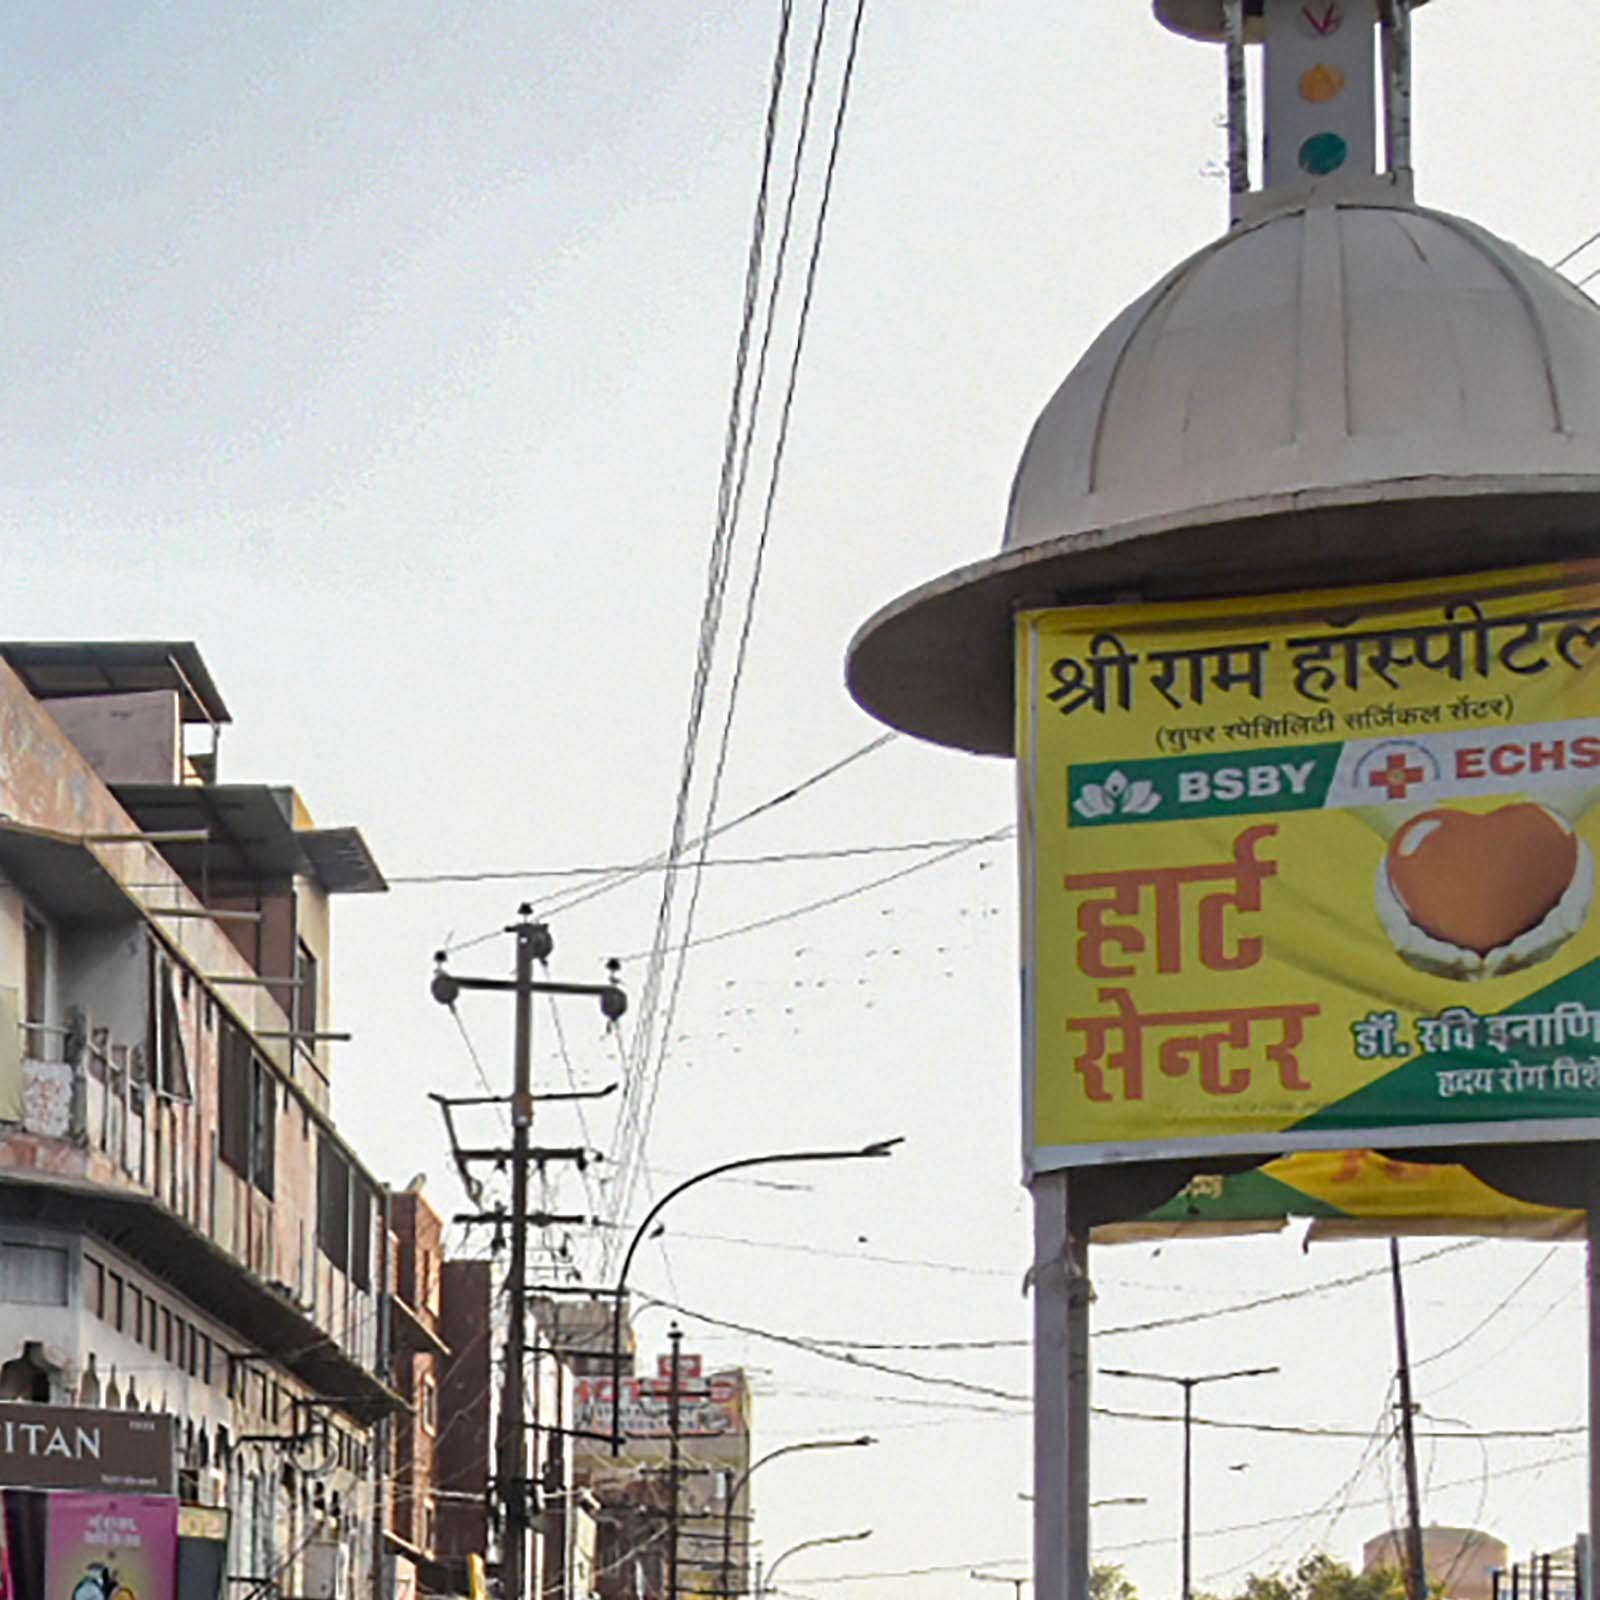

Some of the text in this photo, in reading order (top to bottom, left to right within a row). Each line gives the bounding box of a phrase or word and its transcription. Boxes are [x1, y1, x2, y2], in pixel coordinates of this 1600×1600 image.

[1046, 633, 1138, 715] श्री
[1148, 642, 1270, 710] राम
[1179, 761, 1317, 802] BSBY
[1455, 736, 1600, 780] ECHS
[1064, 824, 1279, 979] हार्ट
[1066, 988, 1321, 1102] सेन्टर
[1353, 1010, 1411, 1057] डॉ.
[1416, 1008, 1479, 1051] रवि
[1500, 1058, 1548, 1092] रोग
